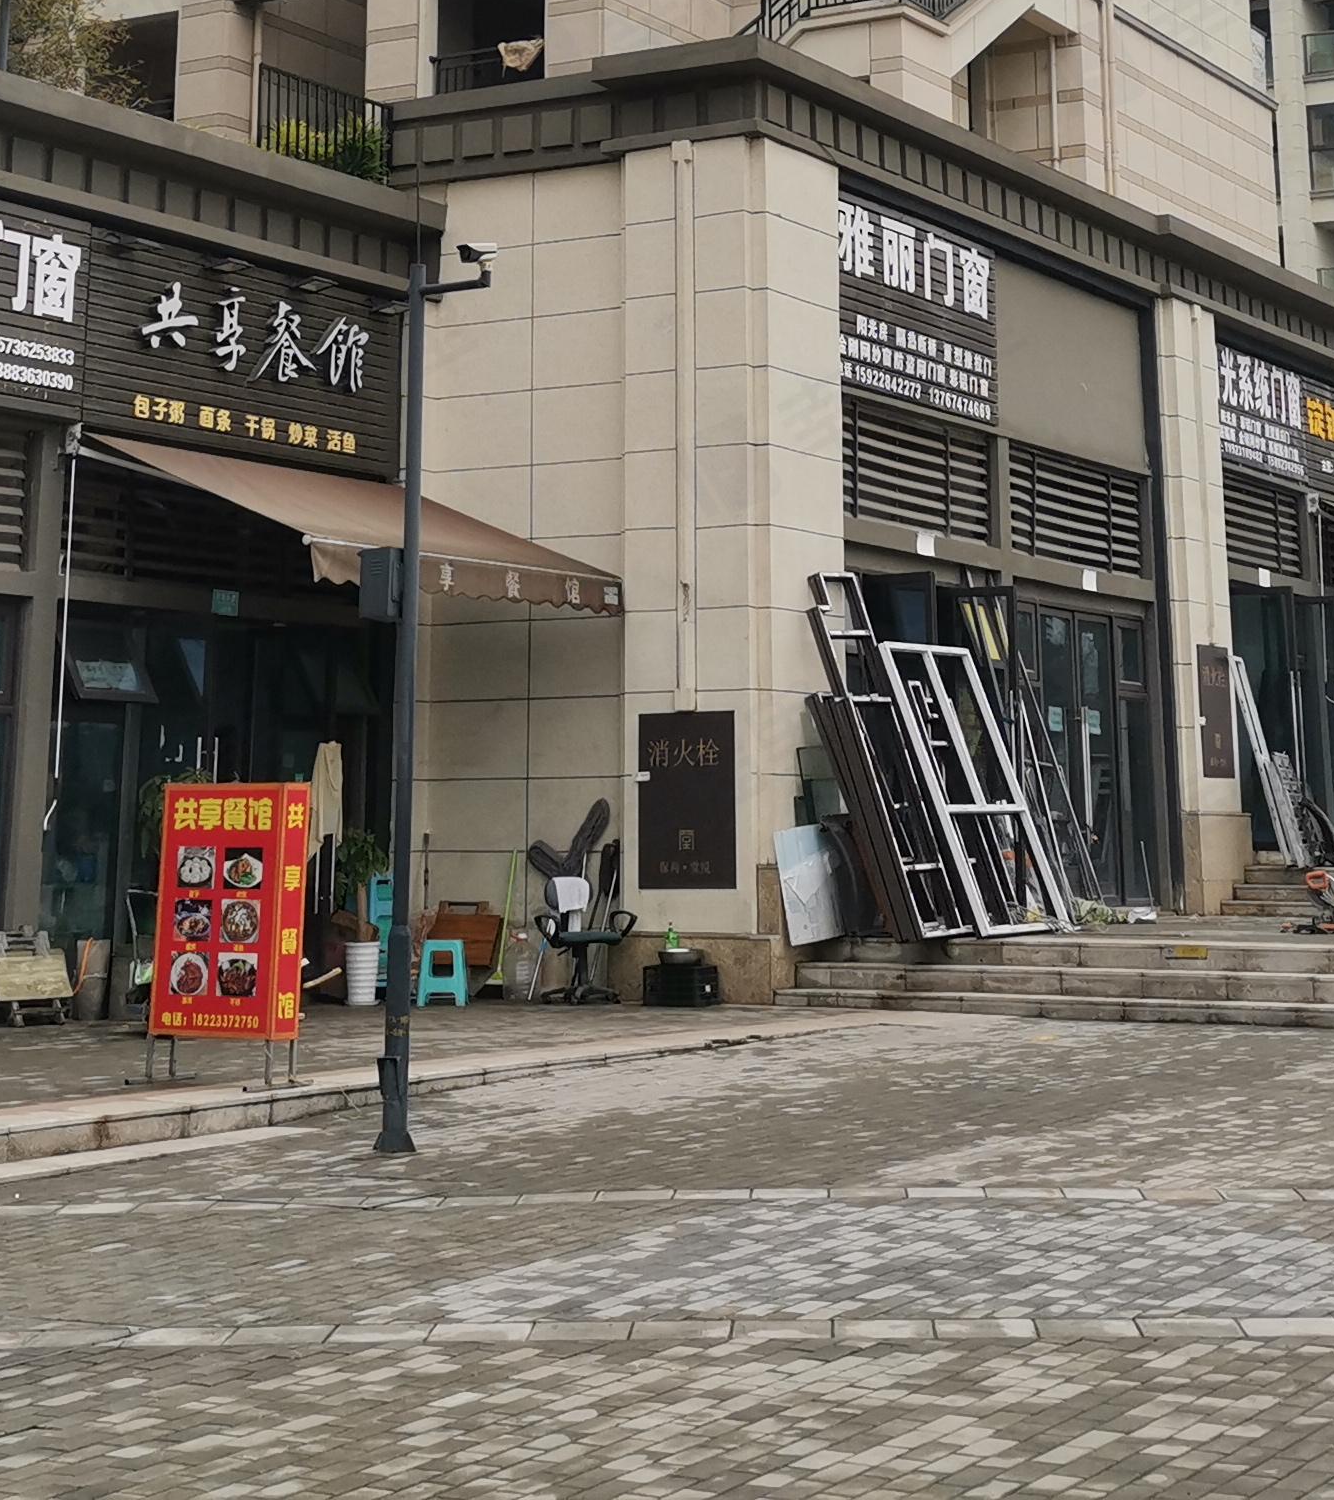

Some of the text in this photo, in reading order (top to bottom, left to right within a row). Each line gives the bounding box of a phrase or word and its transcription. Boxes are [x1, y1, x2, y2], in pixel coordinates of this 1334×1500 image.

[837, 200, 989, 320] 雅丽门窗
[134, 394, 357, 454] 包子粥 面条 干锅 炒菜 活鱼
[647, 737, 720, 767] 消火栓
[174, 797, 273, 831] 共享餐馆
